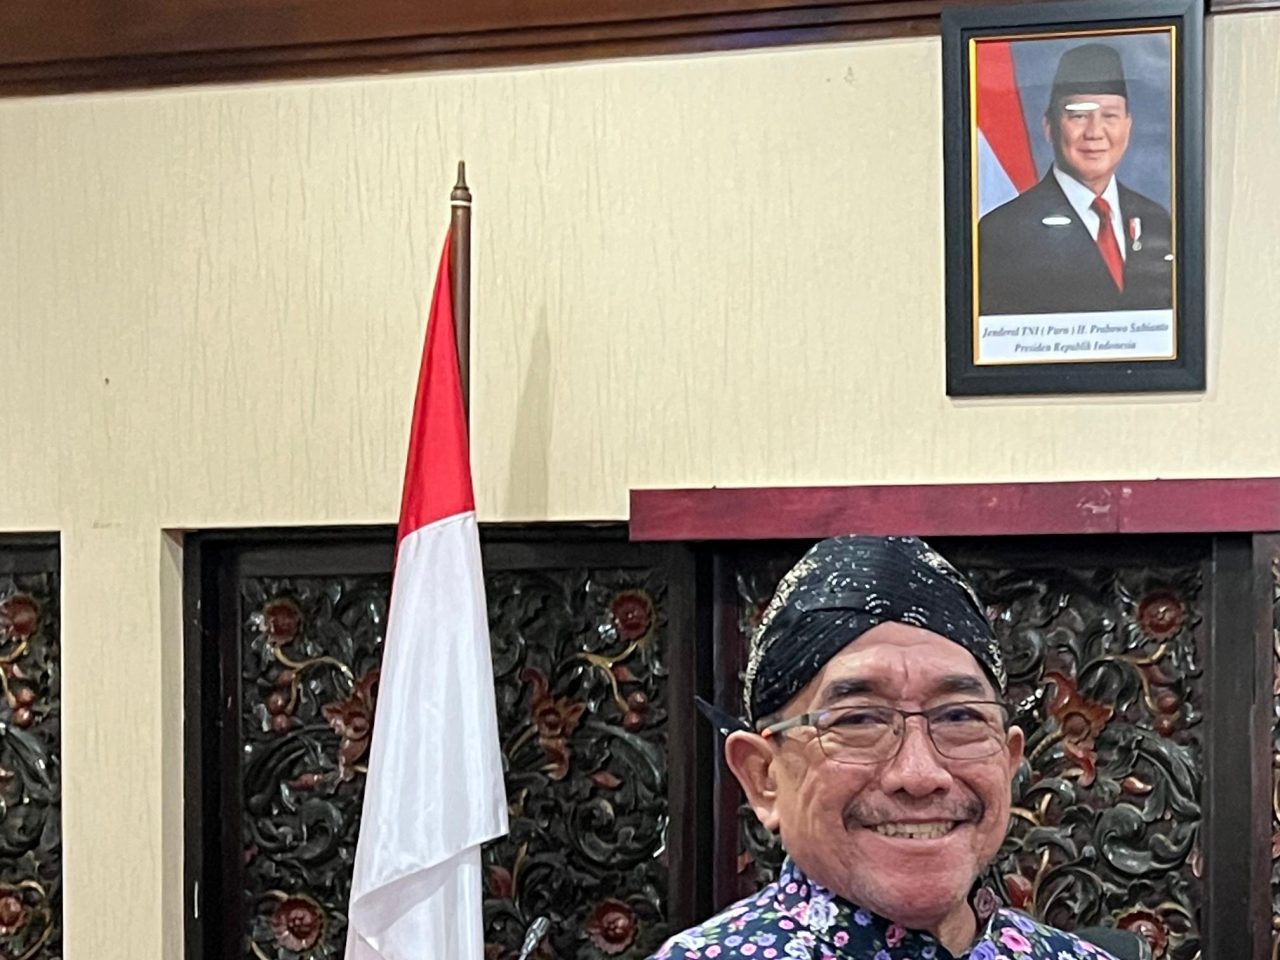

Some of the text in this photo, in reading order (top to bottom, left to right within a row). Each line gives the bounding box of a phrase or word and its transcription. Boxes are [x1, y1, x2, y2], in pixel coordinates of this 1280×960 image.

[982, 326, 1021, 338] Jenderal
[1022, 326, 1040, 337] TNI
[1090, 324, 1128, 334] Prabowo
[1015, 340, 1137, 353] Presiden Republik Indonesia
